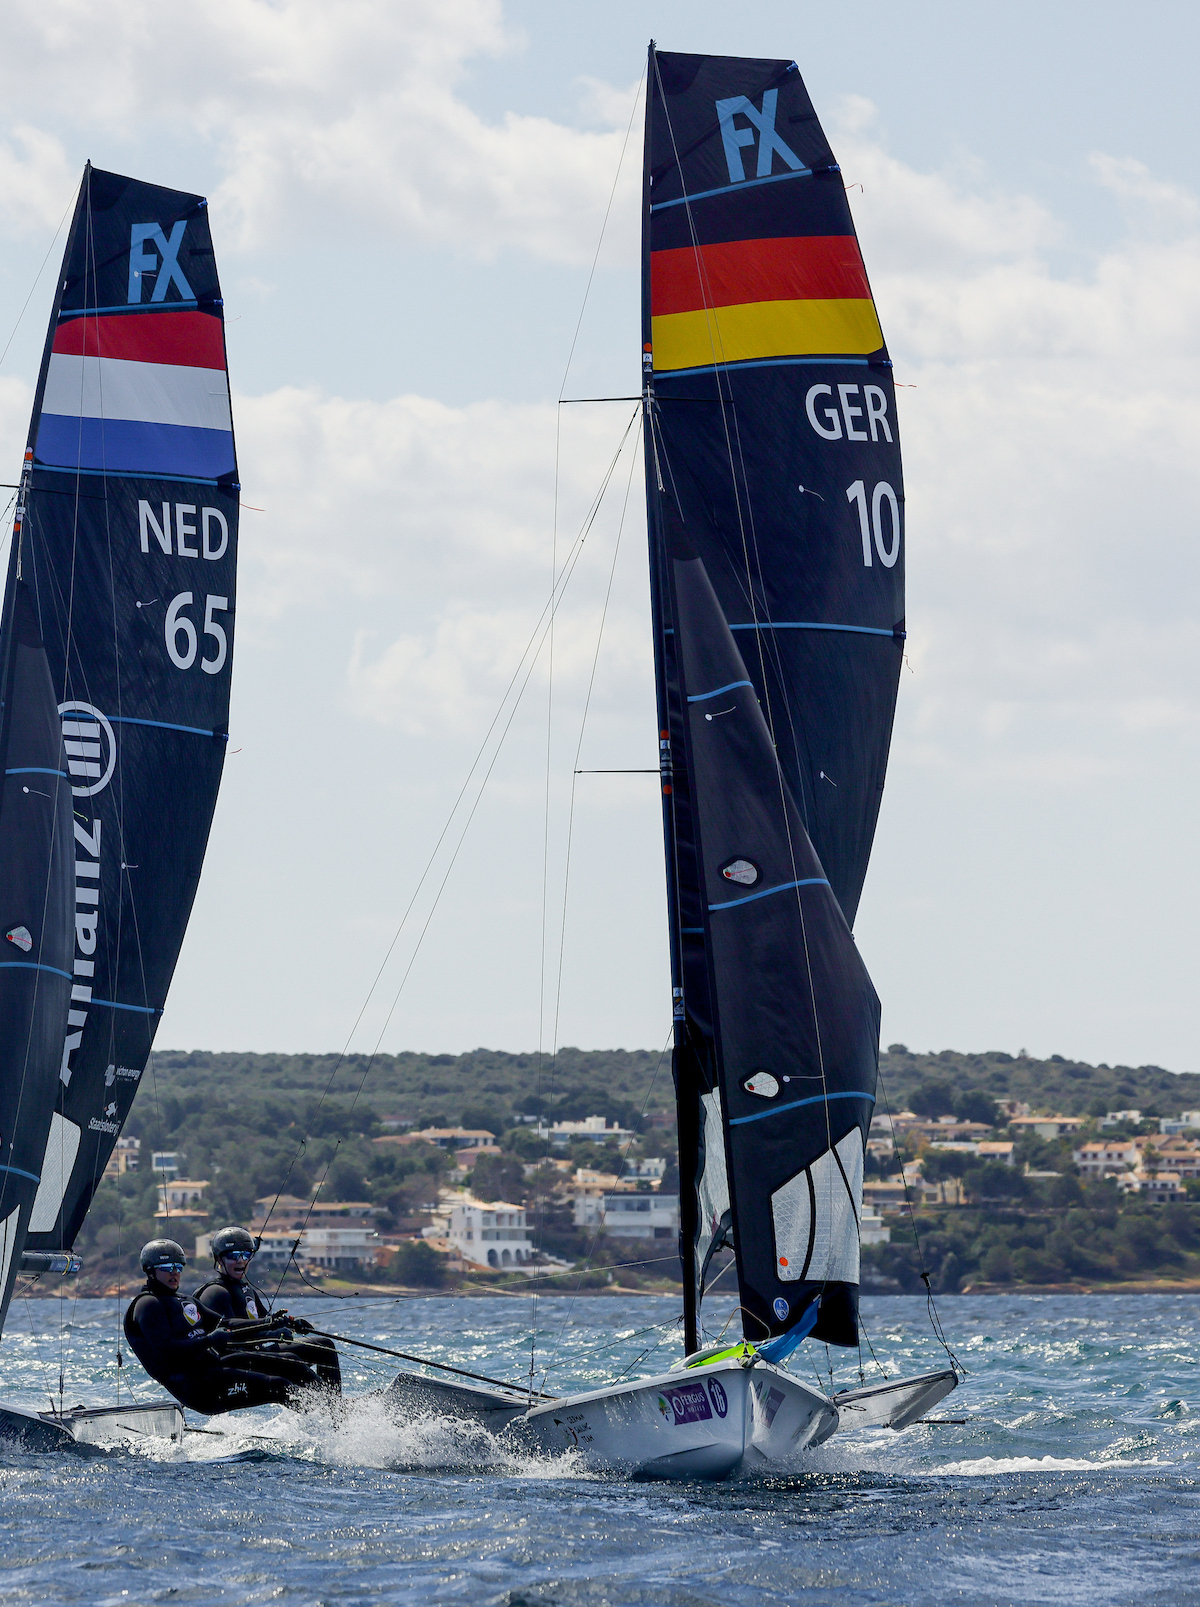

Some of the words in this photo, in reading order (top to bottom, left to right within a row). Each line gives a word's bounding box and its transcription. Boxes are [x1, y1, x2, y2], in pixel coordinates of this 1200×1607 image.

[715, 88, 806, 183] FX
[127, 220, 196, 304] FX
[805, 383, 894, 443] GER
[138, 499, 229, 561] NED
[845, 479, 900, 568] 10
[164, 591, 229, 675] 65
[680, 1391, 706, 1407] FERGUS
[710, 1382, 726, 1413] 16
